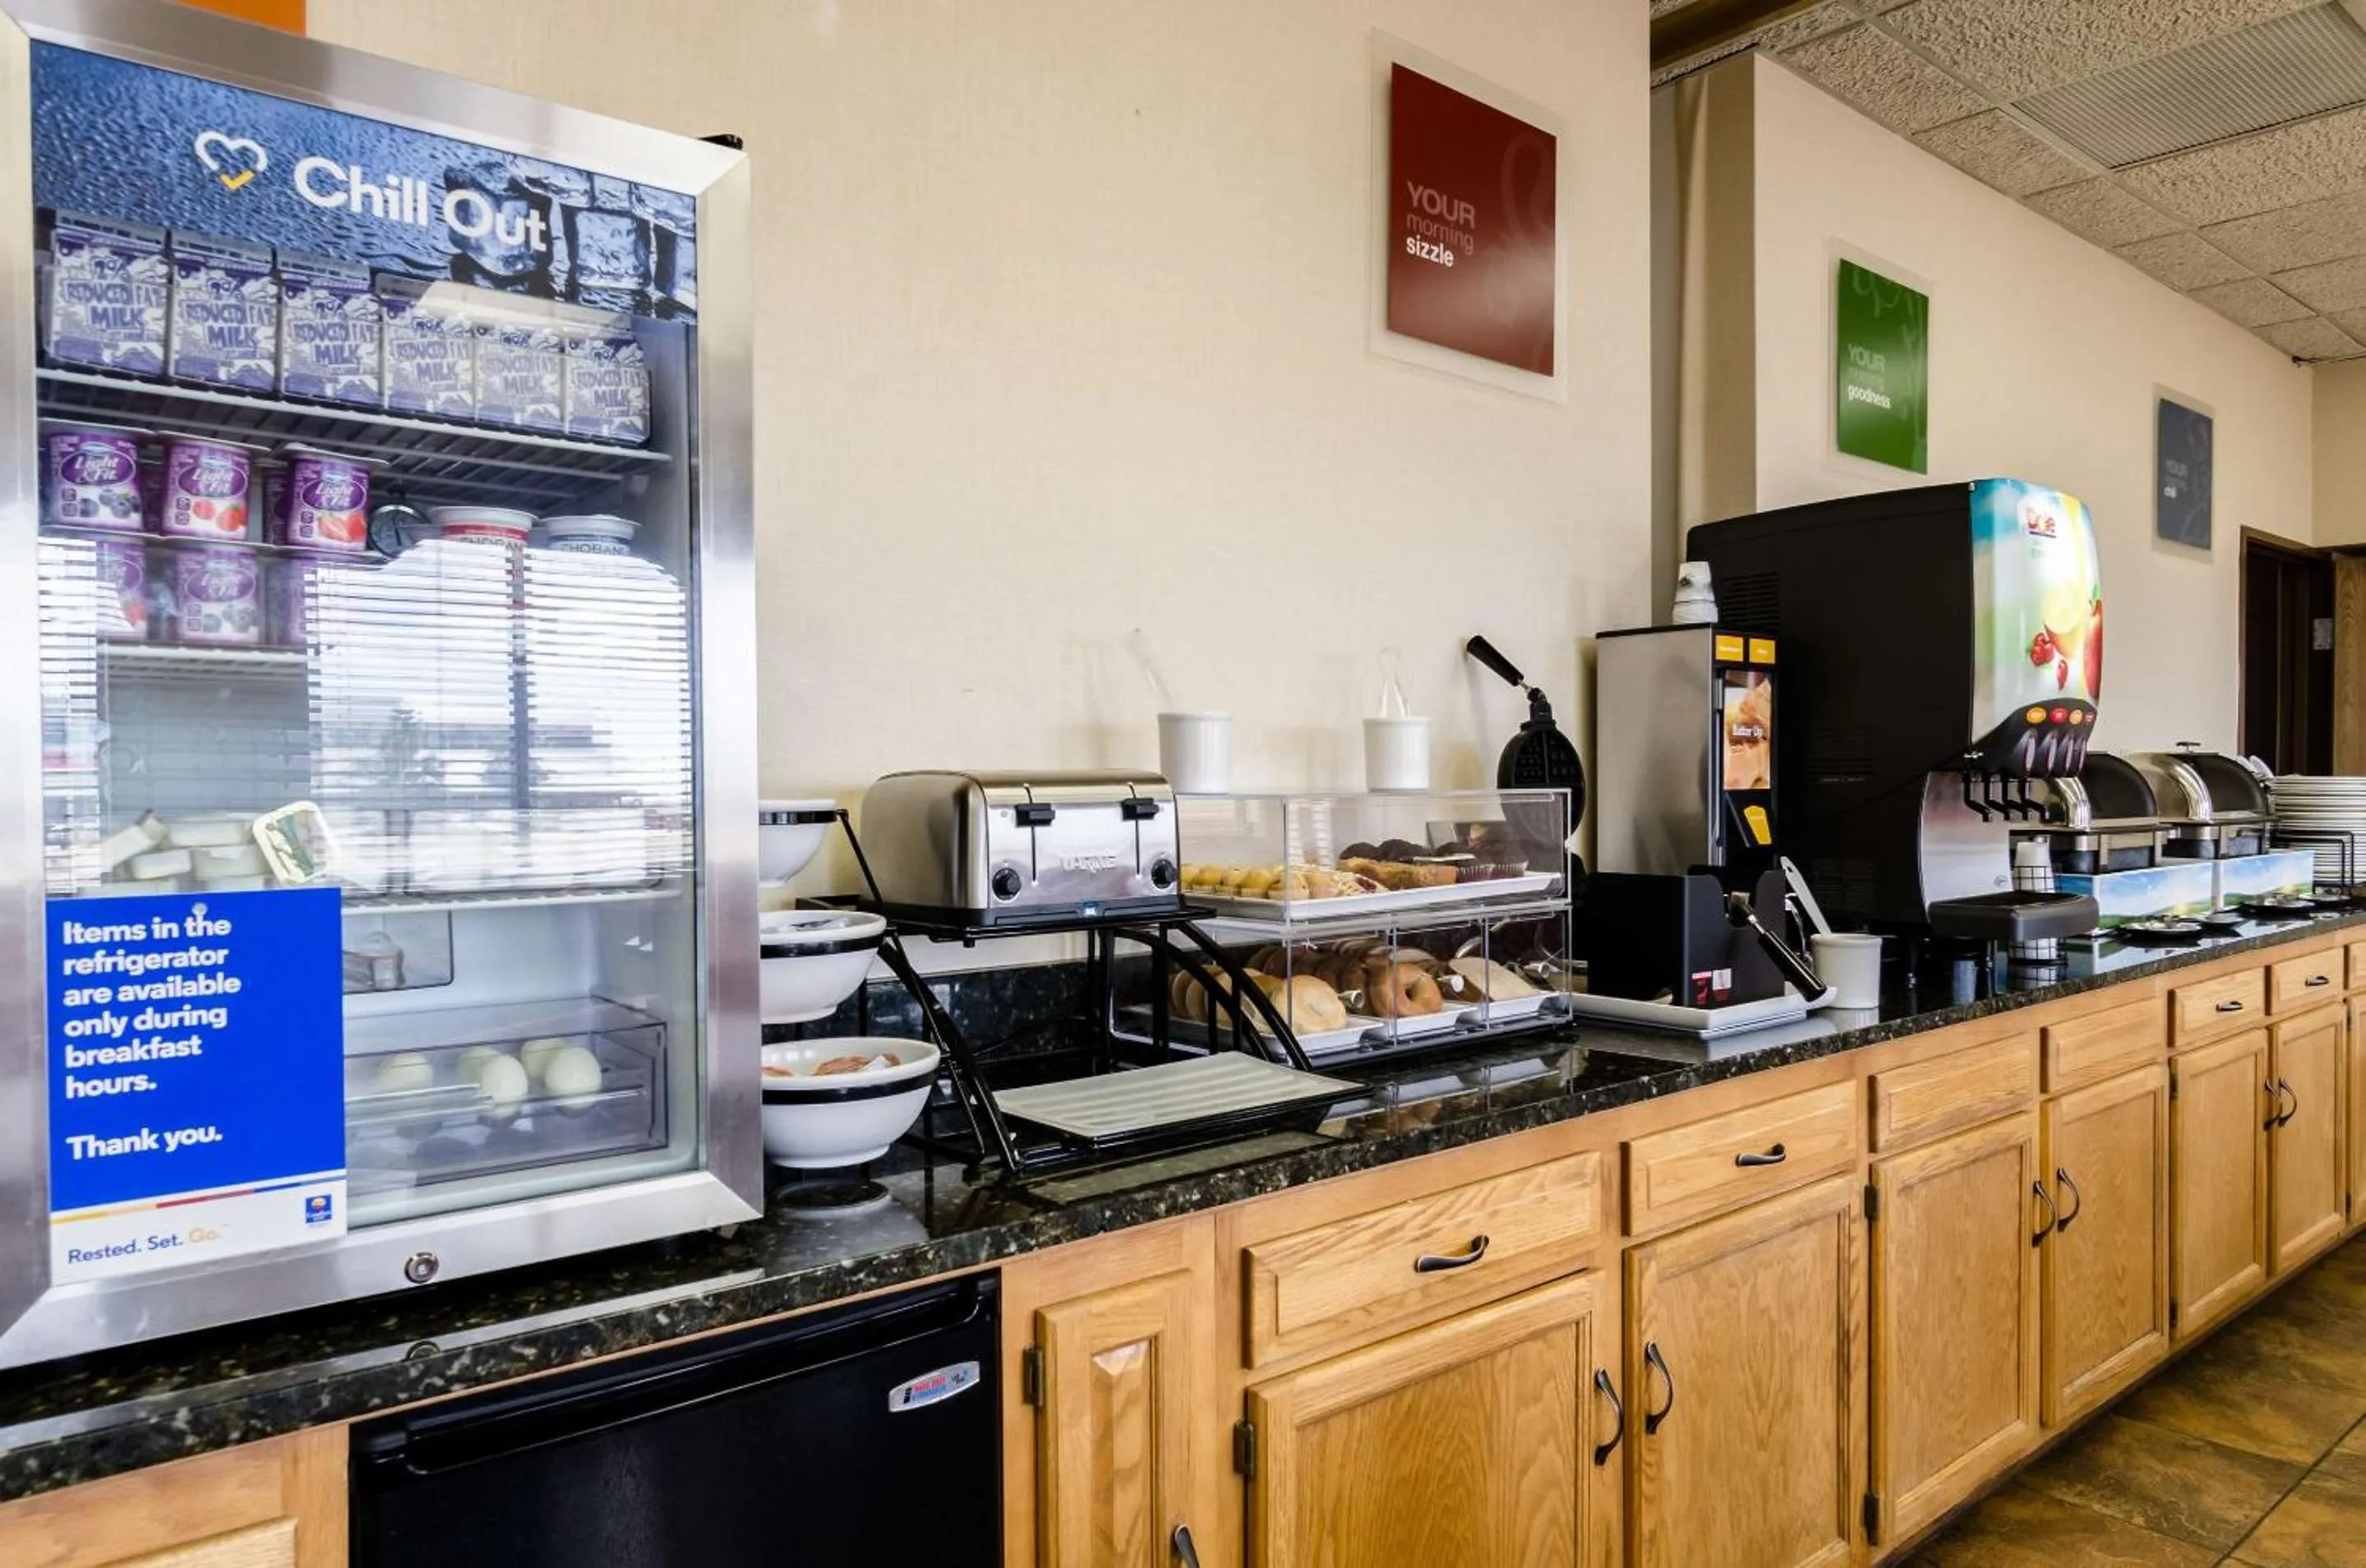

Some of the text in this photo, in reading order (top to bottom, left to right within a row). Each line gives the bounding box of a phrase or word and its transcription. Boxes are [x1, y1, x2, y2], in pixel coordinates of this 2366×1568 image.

[293, 155, 547, 251] Chill Out
[1407, 179, 1476, 230] YOUR
[1406, 213, 1474, 256] morning
[1406, 234, 1455, 268] sizzle
[88, 305, 145, 330] MILK
[207, 325, 258, 351] MILK
[313, 344, 362, 366] MILK
[1847, 344, 1886, 375] YOUR
[417, 361, 458, 382] MILK
[502, 375, 543, 396] MILK
[593, 388, 631, 408] MILK
[62, 914, 232, 944] Items in the
[62, 946, 230, 976] refrigerator
[62, 972, 242, 1007] are available
[63, 1004, 228, 1039] only during
[65, 1034, 203, 1068] breakfast
[66, 1072, 158, 1100] hours.
[66, 1125, 223, 1160] Thank you.
[67, 1238, 142, 1264] Rested.
[146, 1232, 184, 1251] Set.
